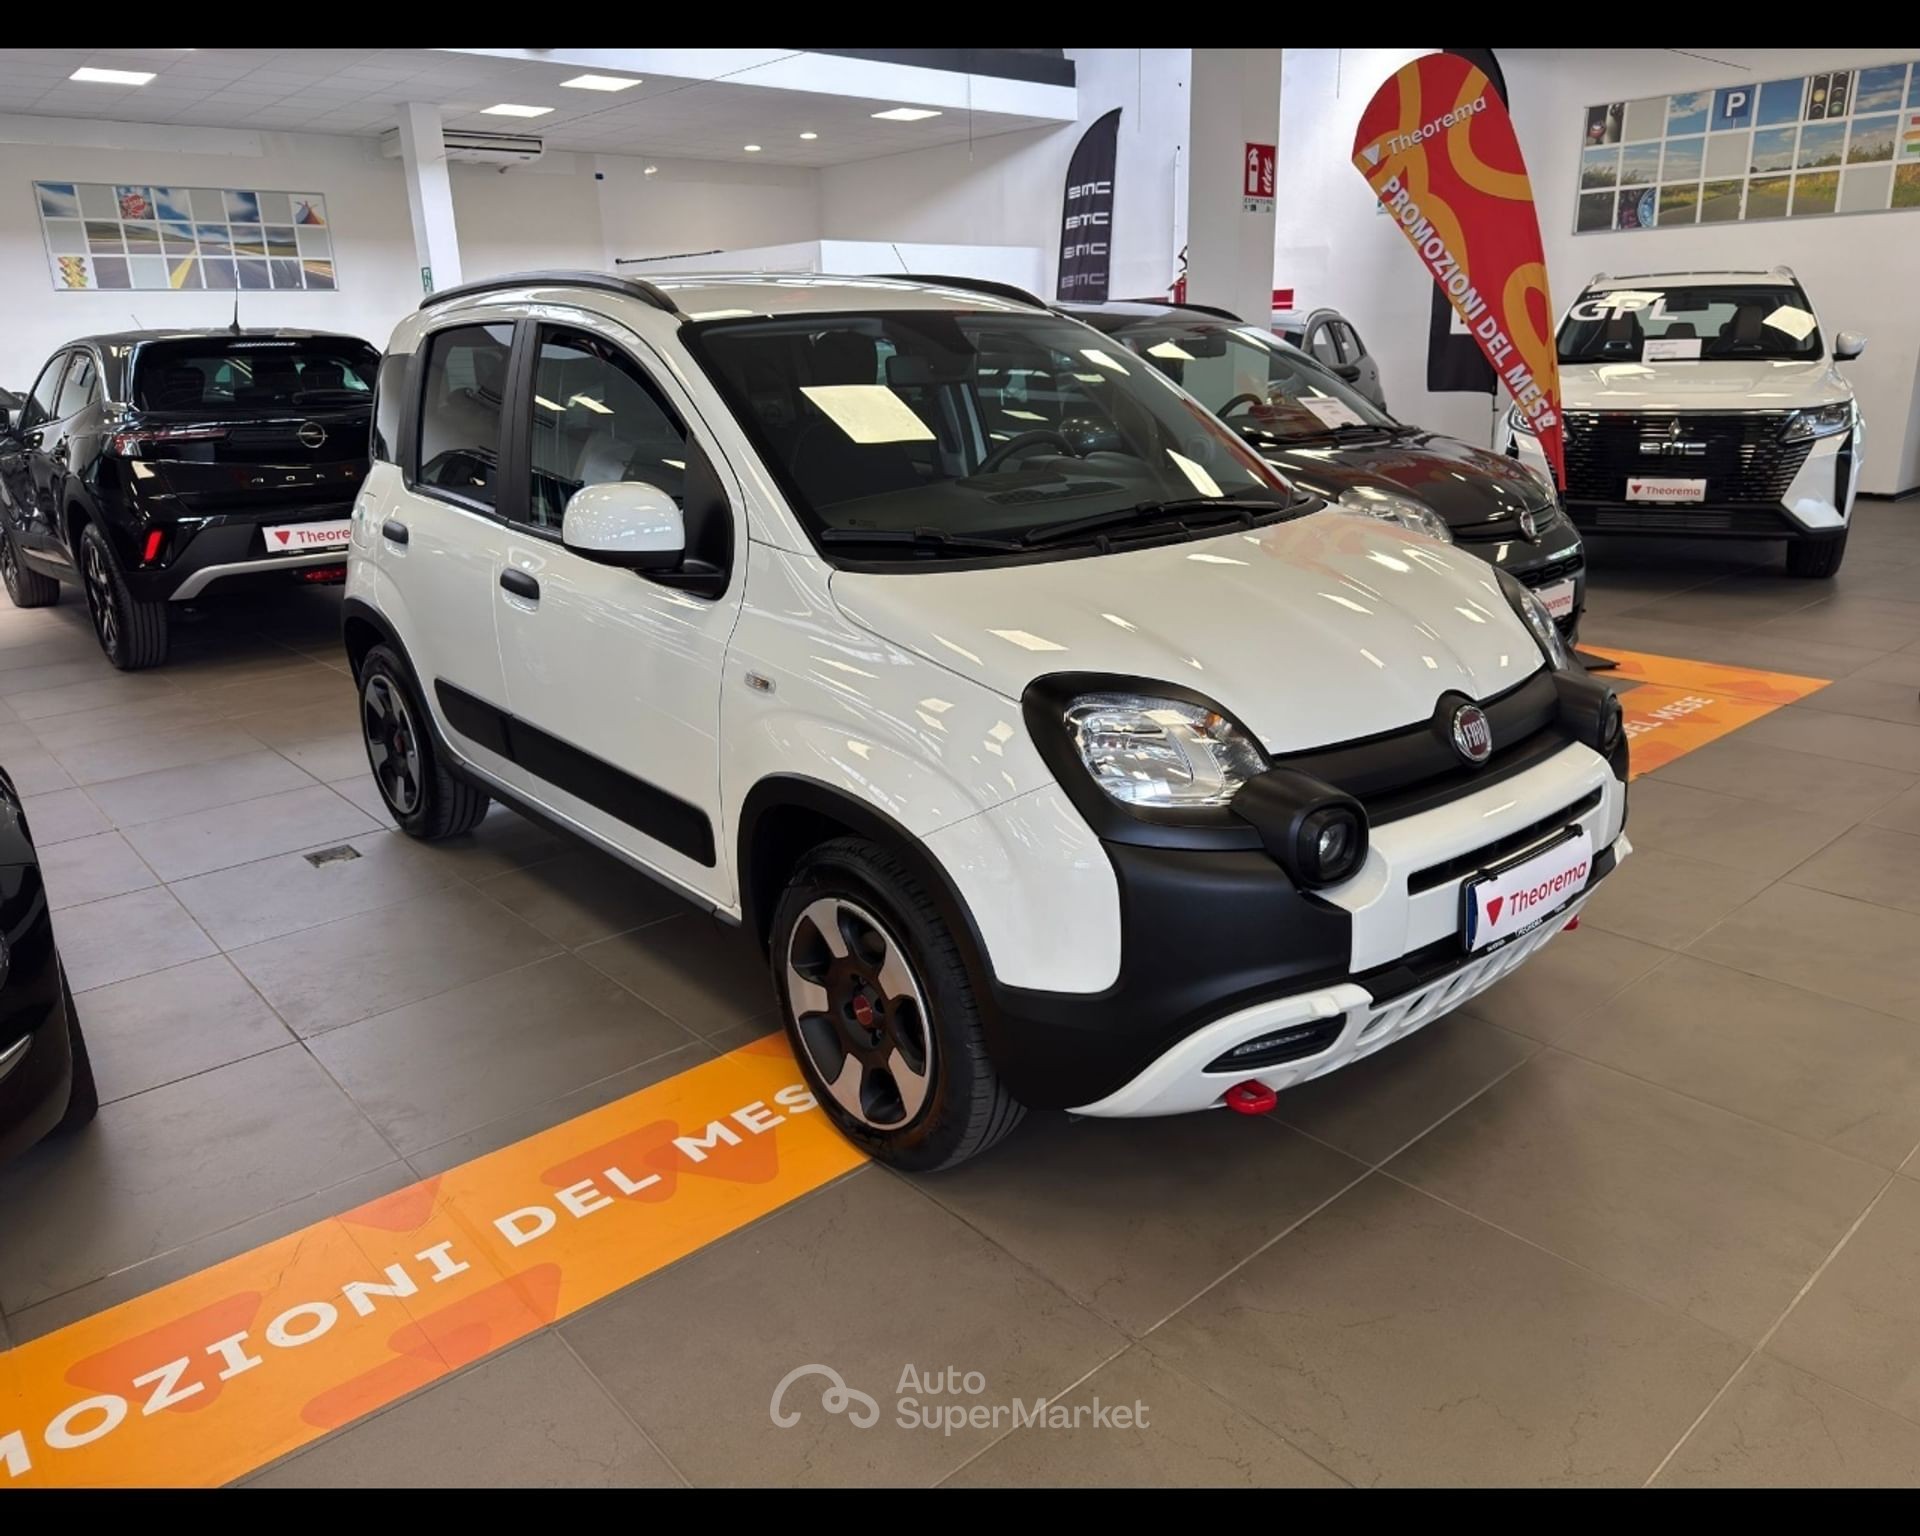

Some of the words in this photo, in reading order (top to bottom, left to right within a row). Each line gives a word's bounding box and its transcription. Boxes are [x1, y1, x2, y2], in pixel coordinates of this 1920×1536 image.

[1725, 91, 1746, 118] P
[1387, 96, 1487, 155] Theorema
[1068, 181, 1111, 200] EMC
[1065, 212, 1109, 230] EMC
[1063, 242, 1107, 260] EMC
[1381, 175, 1487, 321] PROMOZIONI
[1476, 316, 1513, 368] DEL
[1504, 363, 1557, 433] MESE
[1569, 298, 1679, 321] GPL
[1646, 486, 1701, 496] Theorema
[1648, 696, 1715, 720] MESE
[1463, 720, 1485, 748] FIAT
[1509, 861, 1588, 916] Theorema
[493, 1166, 662, 1248] DEL
